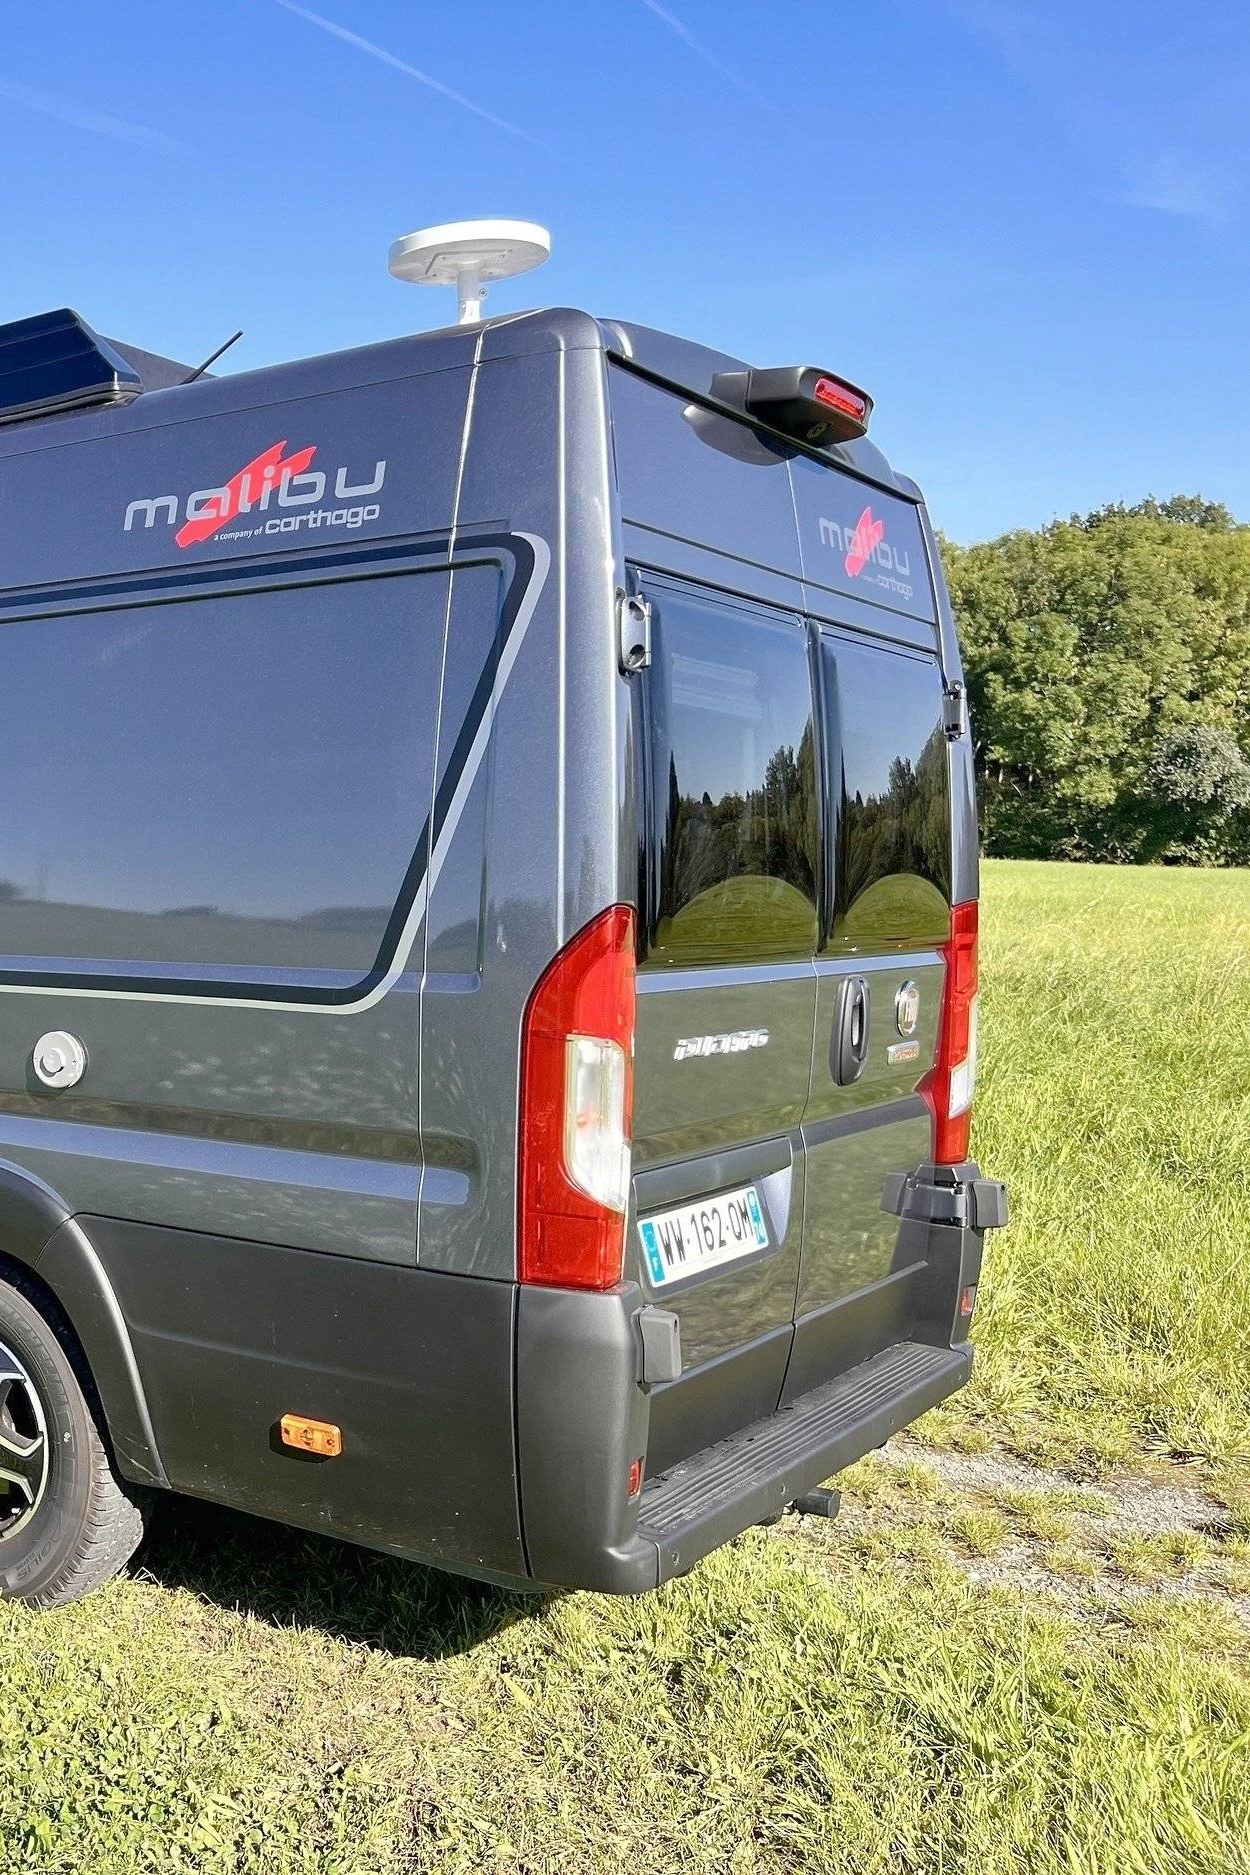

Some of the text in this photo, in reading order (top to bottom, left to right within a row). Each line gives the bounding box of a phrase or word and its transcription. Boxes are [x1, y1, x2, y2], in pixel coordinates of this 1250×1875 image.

[123, 460, 387, 531] malibu
[213, 504, 381, 541] a company of carthago
